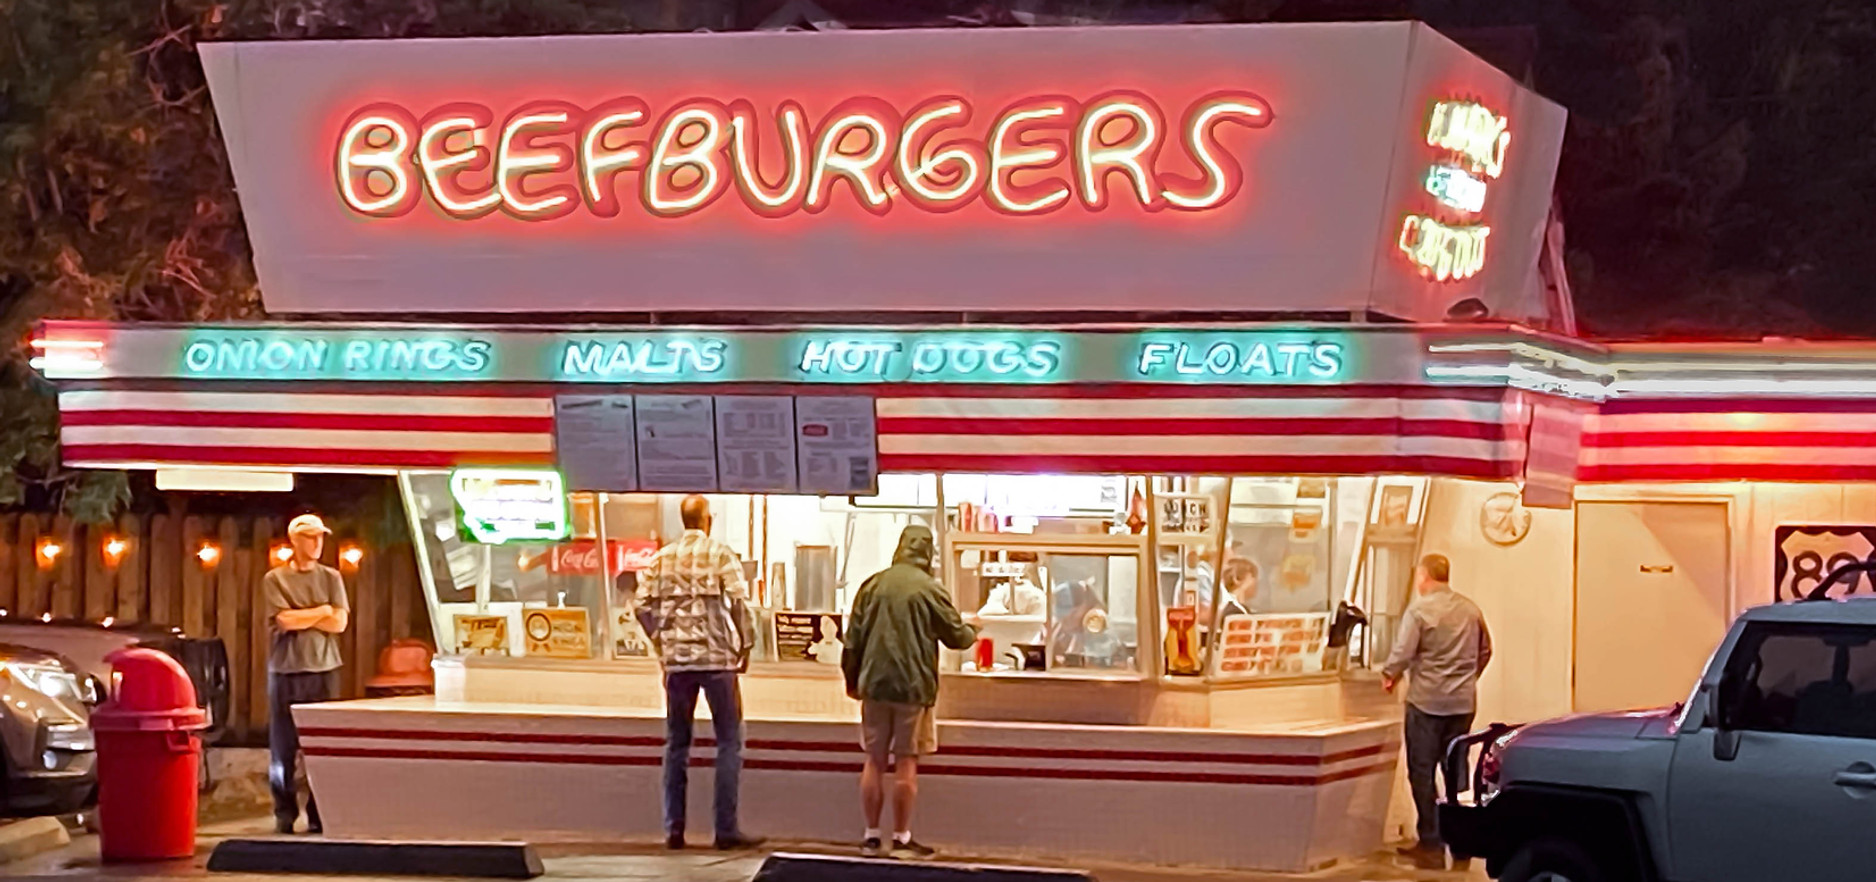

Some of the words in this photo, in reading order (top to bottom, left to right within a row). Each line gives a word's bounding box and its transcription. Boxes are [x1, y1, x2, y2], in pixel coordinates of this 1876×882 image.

[338, 90, 1272, 219] BEEFBURGERS
[185, 339, 328, 372] ONION
[344, 339, 490, 372] RINGS
[562, 339, 727, 375] MALTS
[799, 340, 902, 374] HOT
[912, 341, 1060, 376] DOGS
[1138, 341, 1343, 376] FLOATS
[1791, 550, 1861, 599] 89
